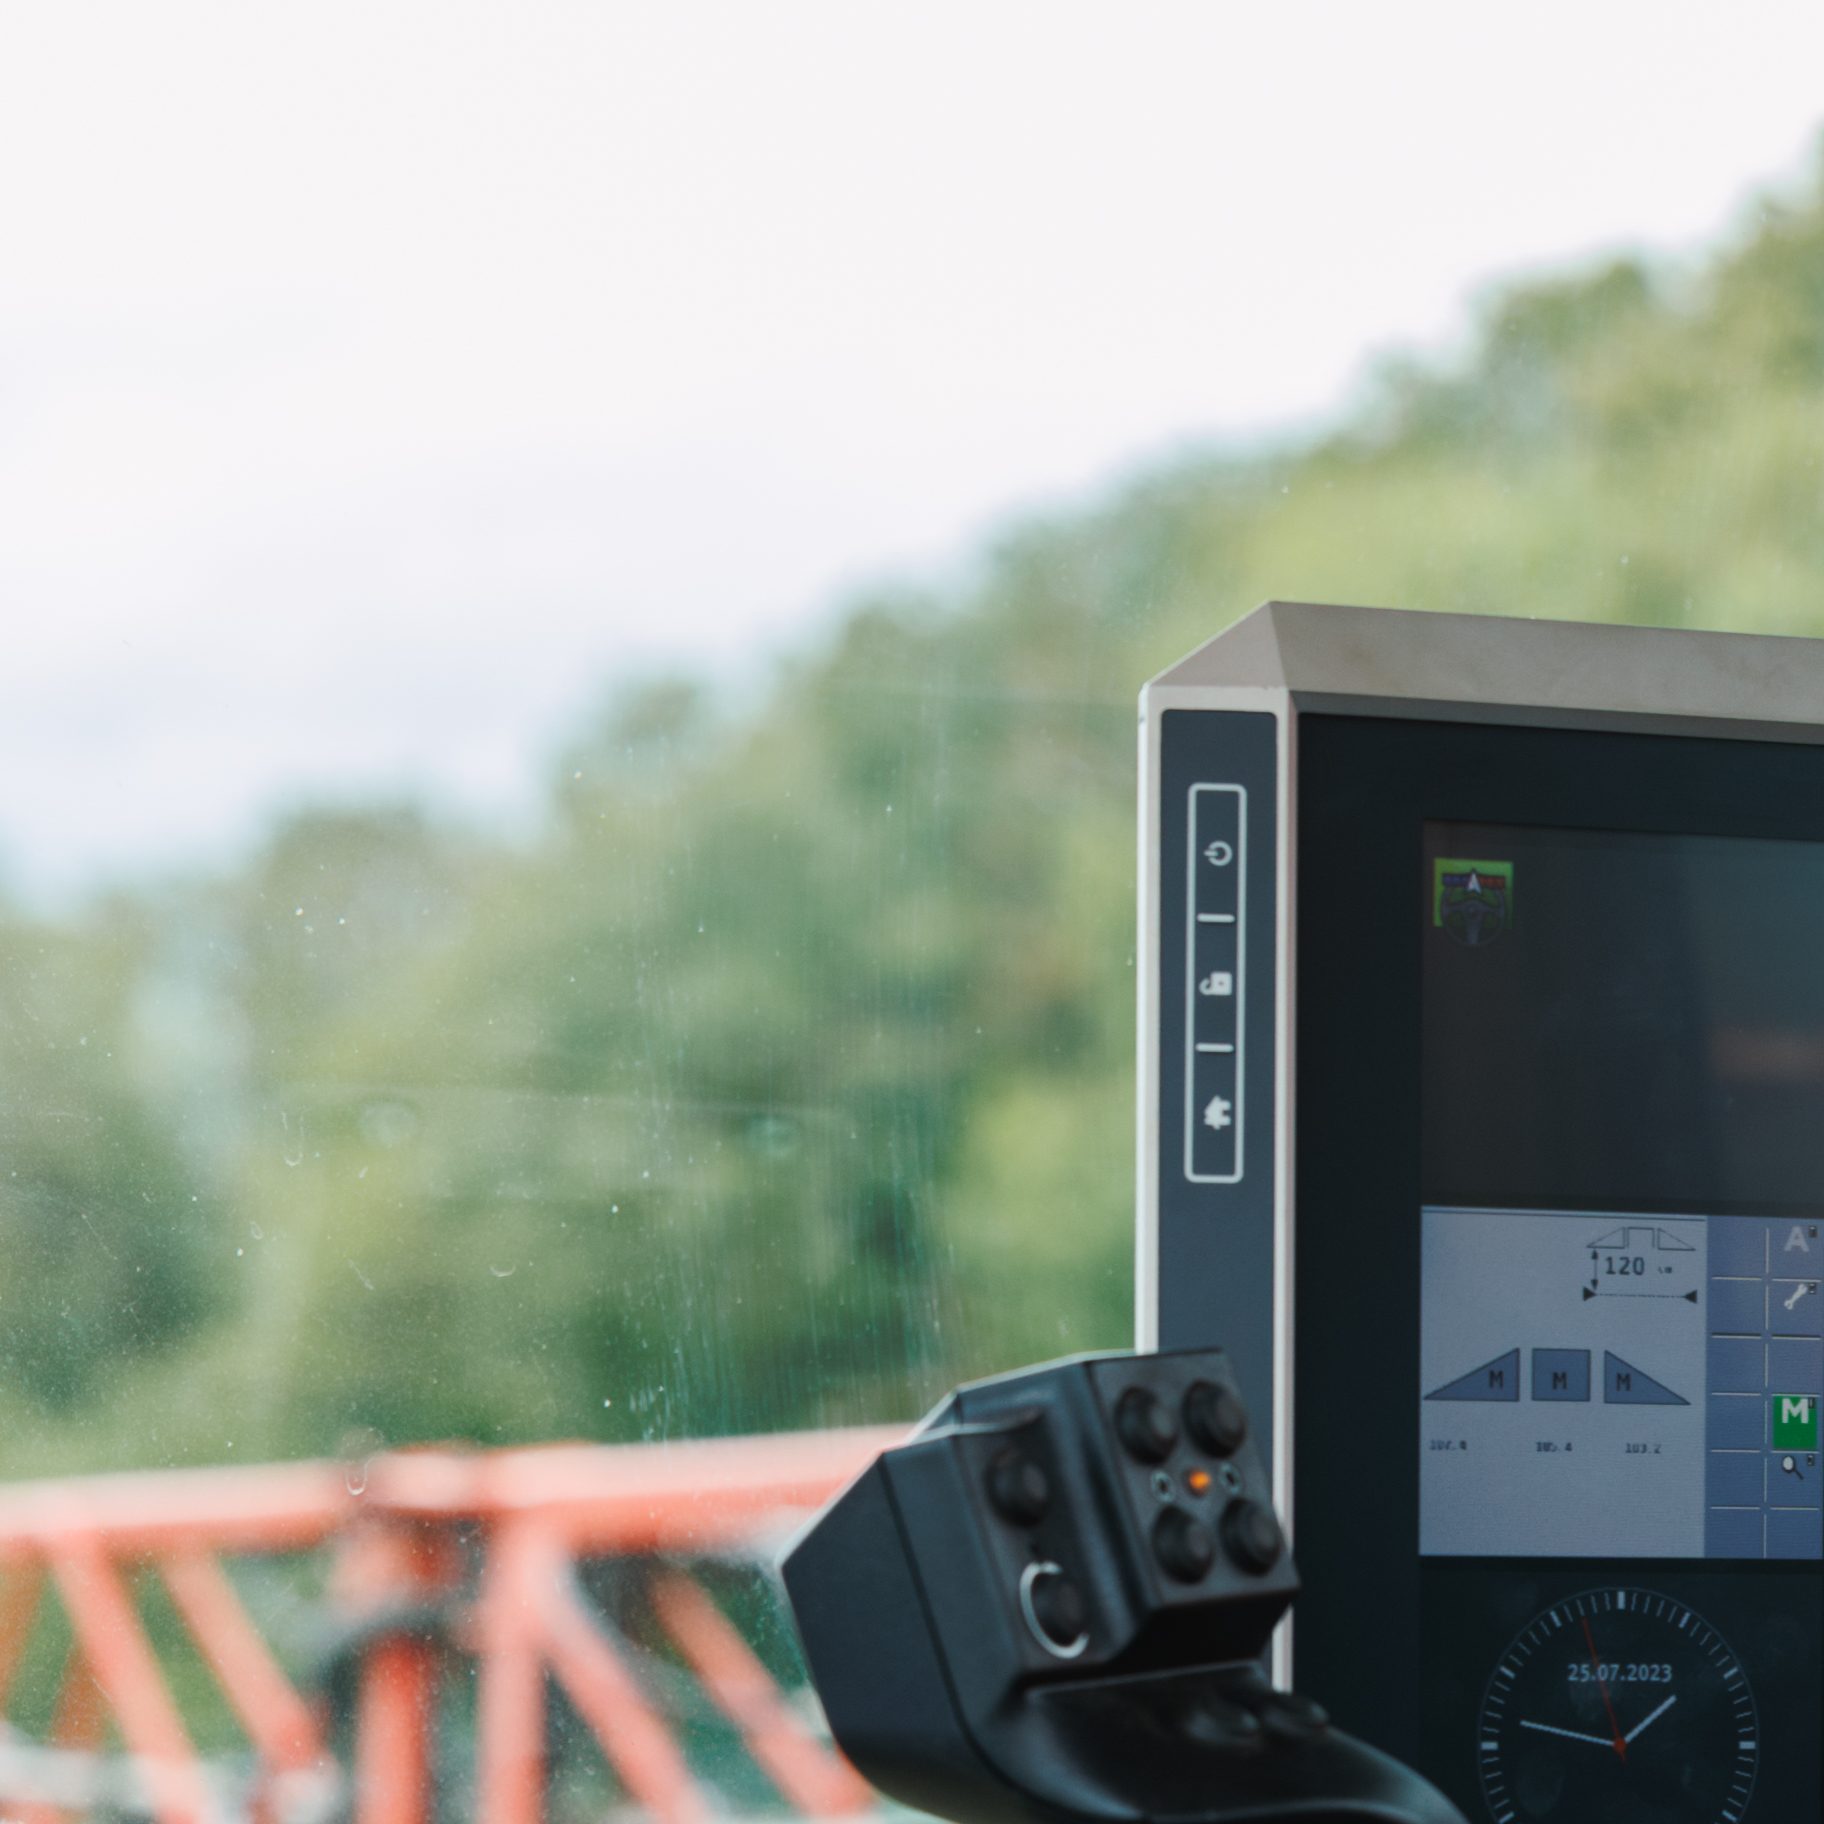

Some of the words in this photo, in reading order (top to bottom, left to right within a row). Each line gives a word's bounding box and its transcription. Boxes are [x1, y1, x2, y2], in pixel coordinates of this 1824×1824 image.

[1784, 1226, 1810, 1252] A
[1605, 1256, 1645, 1276] 120
[1488, 1370, 1504, 1389] M
[1552, 1371, 1568, 1390] M
[1616, 1372, 1631, 1391] M
[1782, 1398, 1809, 1424] M
[1567, 1664, 1673, 1683] 25.07.2023
